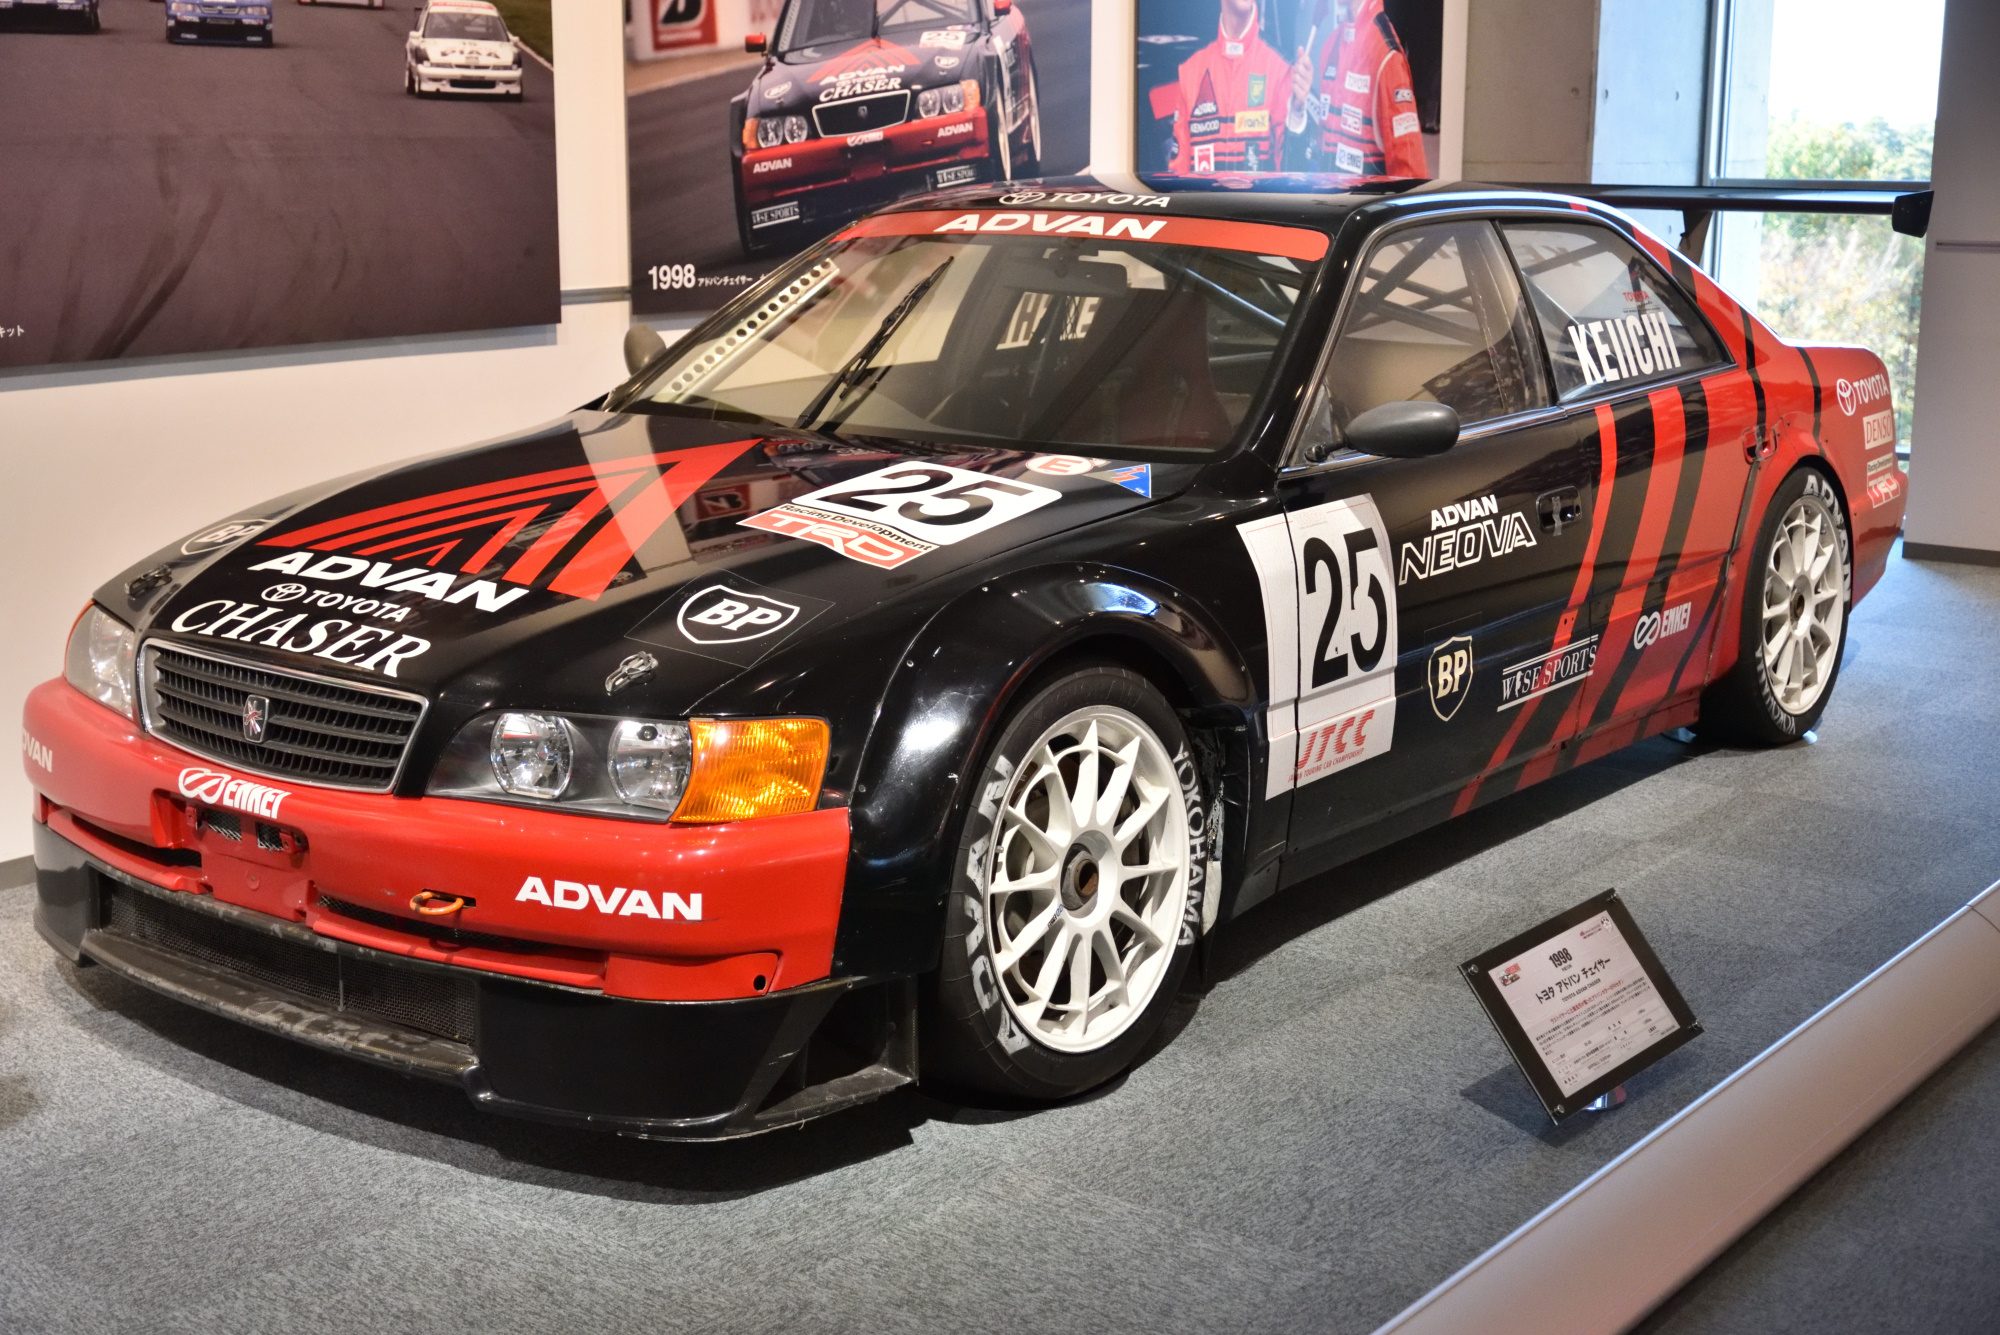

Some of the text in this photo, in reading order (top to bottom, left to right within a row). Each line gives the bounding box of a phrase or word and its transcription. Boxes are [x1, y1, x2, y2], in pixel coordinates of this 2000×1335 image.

[819, 64, 905, 86] ADVAN
[819, 77, 902, 102] CHASER
[937, 121, 973, 138] ADVAN
[753, 158, 793, 174] ADVAN
[1049, 192, 1171, 208] TOYOTA
[933, 214, 1168, 239] ADVAN
[648, 263, 696, 291] 1998
[1568, 312, 1681, 385] KEIICHI
[1853, 374, 1890, 405] TOYOTA
[1865, 415, 1892, 444] DENSO
[815, 468, 1035, 526] 25
[1431, 494, 1499, 531] ADVAN
[195, 525, 264, 545] BP
[769, 513, 905, 561] TRD
[780, 504, 933, 551] Racing Development
[1398, 511, 1538, 586] NEOVA
[247, 551, 529, 613] ADVAN
[302, 589, 412, 623] TOYOTA
[687, 598, 782, 631] BP
[1303, 527, 1388, 690] 25
[1660, 602, 1692, 639] ENKEI
[171, 599, 431, 678] CHASER
[1436, 649, 1468, 699] BP
[1542, 645, 1598, 686] SPORTS
[1297, 709, 1375, 770] JTCC
[222, 779, 292, 819] ENKEI
[1172, 741, 1208, 946] YOKOHAMA
[514, 876, 702, 921] ADVAN
[1548, 947, 1573, 969] 1998
[1535, 985, 1556, 1004] トヨタ
[1556, 974, 1581, 994] アドバン
[1582, 957, 1611, 980] チェイサー
